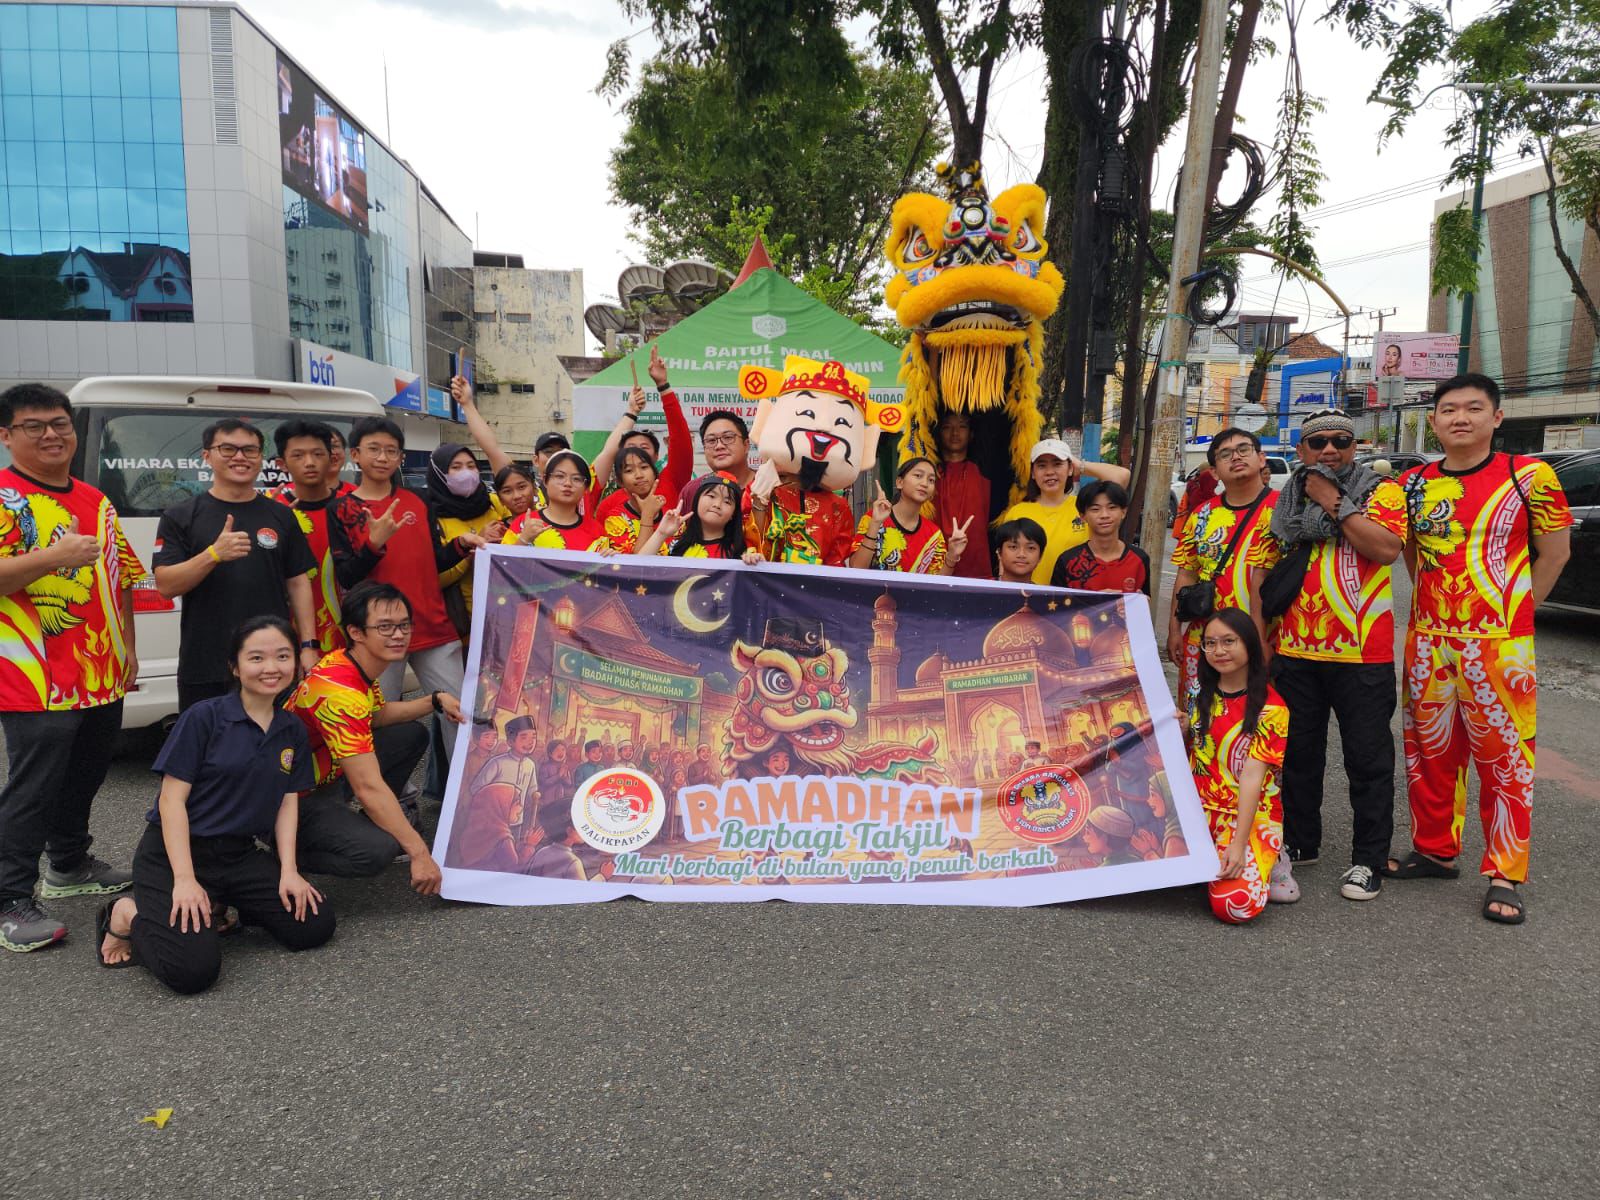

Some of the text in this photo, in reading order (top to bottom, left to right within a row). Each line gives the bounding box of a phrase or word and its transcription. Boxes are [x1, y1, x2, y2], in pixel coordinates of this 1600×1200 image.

[704, 343, 835, 361] BAITUL MAAL
[309, 350, 335, 387] btn
[683, 392, 705, 403] DAN
[104, 457, 174, 470] VIHARA
[600, 661, 630, 676] SELAMAT
[952, 672, 1028, 689] RAMADHAN MUBARAK
[581, 667, 684, 697] IBADAH PUASA RAMADHAN
[684, 780, 977, 835] RAMADHAN
[580, 823, 651, 847] BALIKPAPAN
[719, 819, 947, 858] Berbagi Takjil
[615, 846, 1055, 882] Mari berbagi di bulan yang penuh berkah
